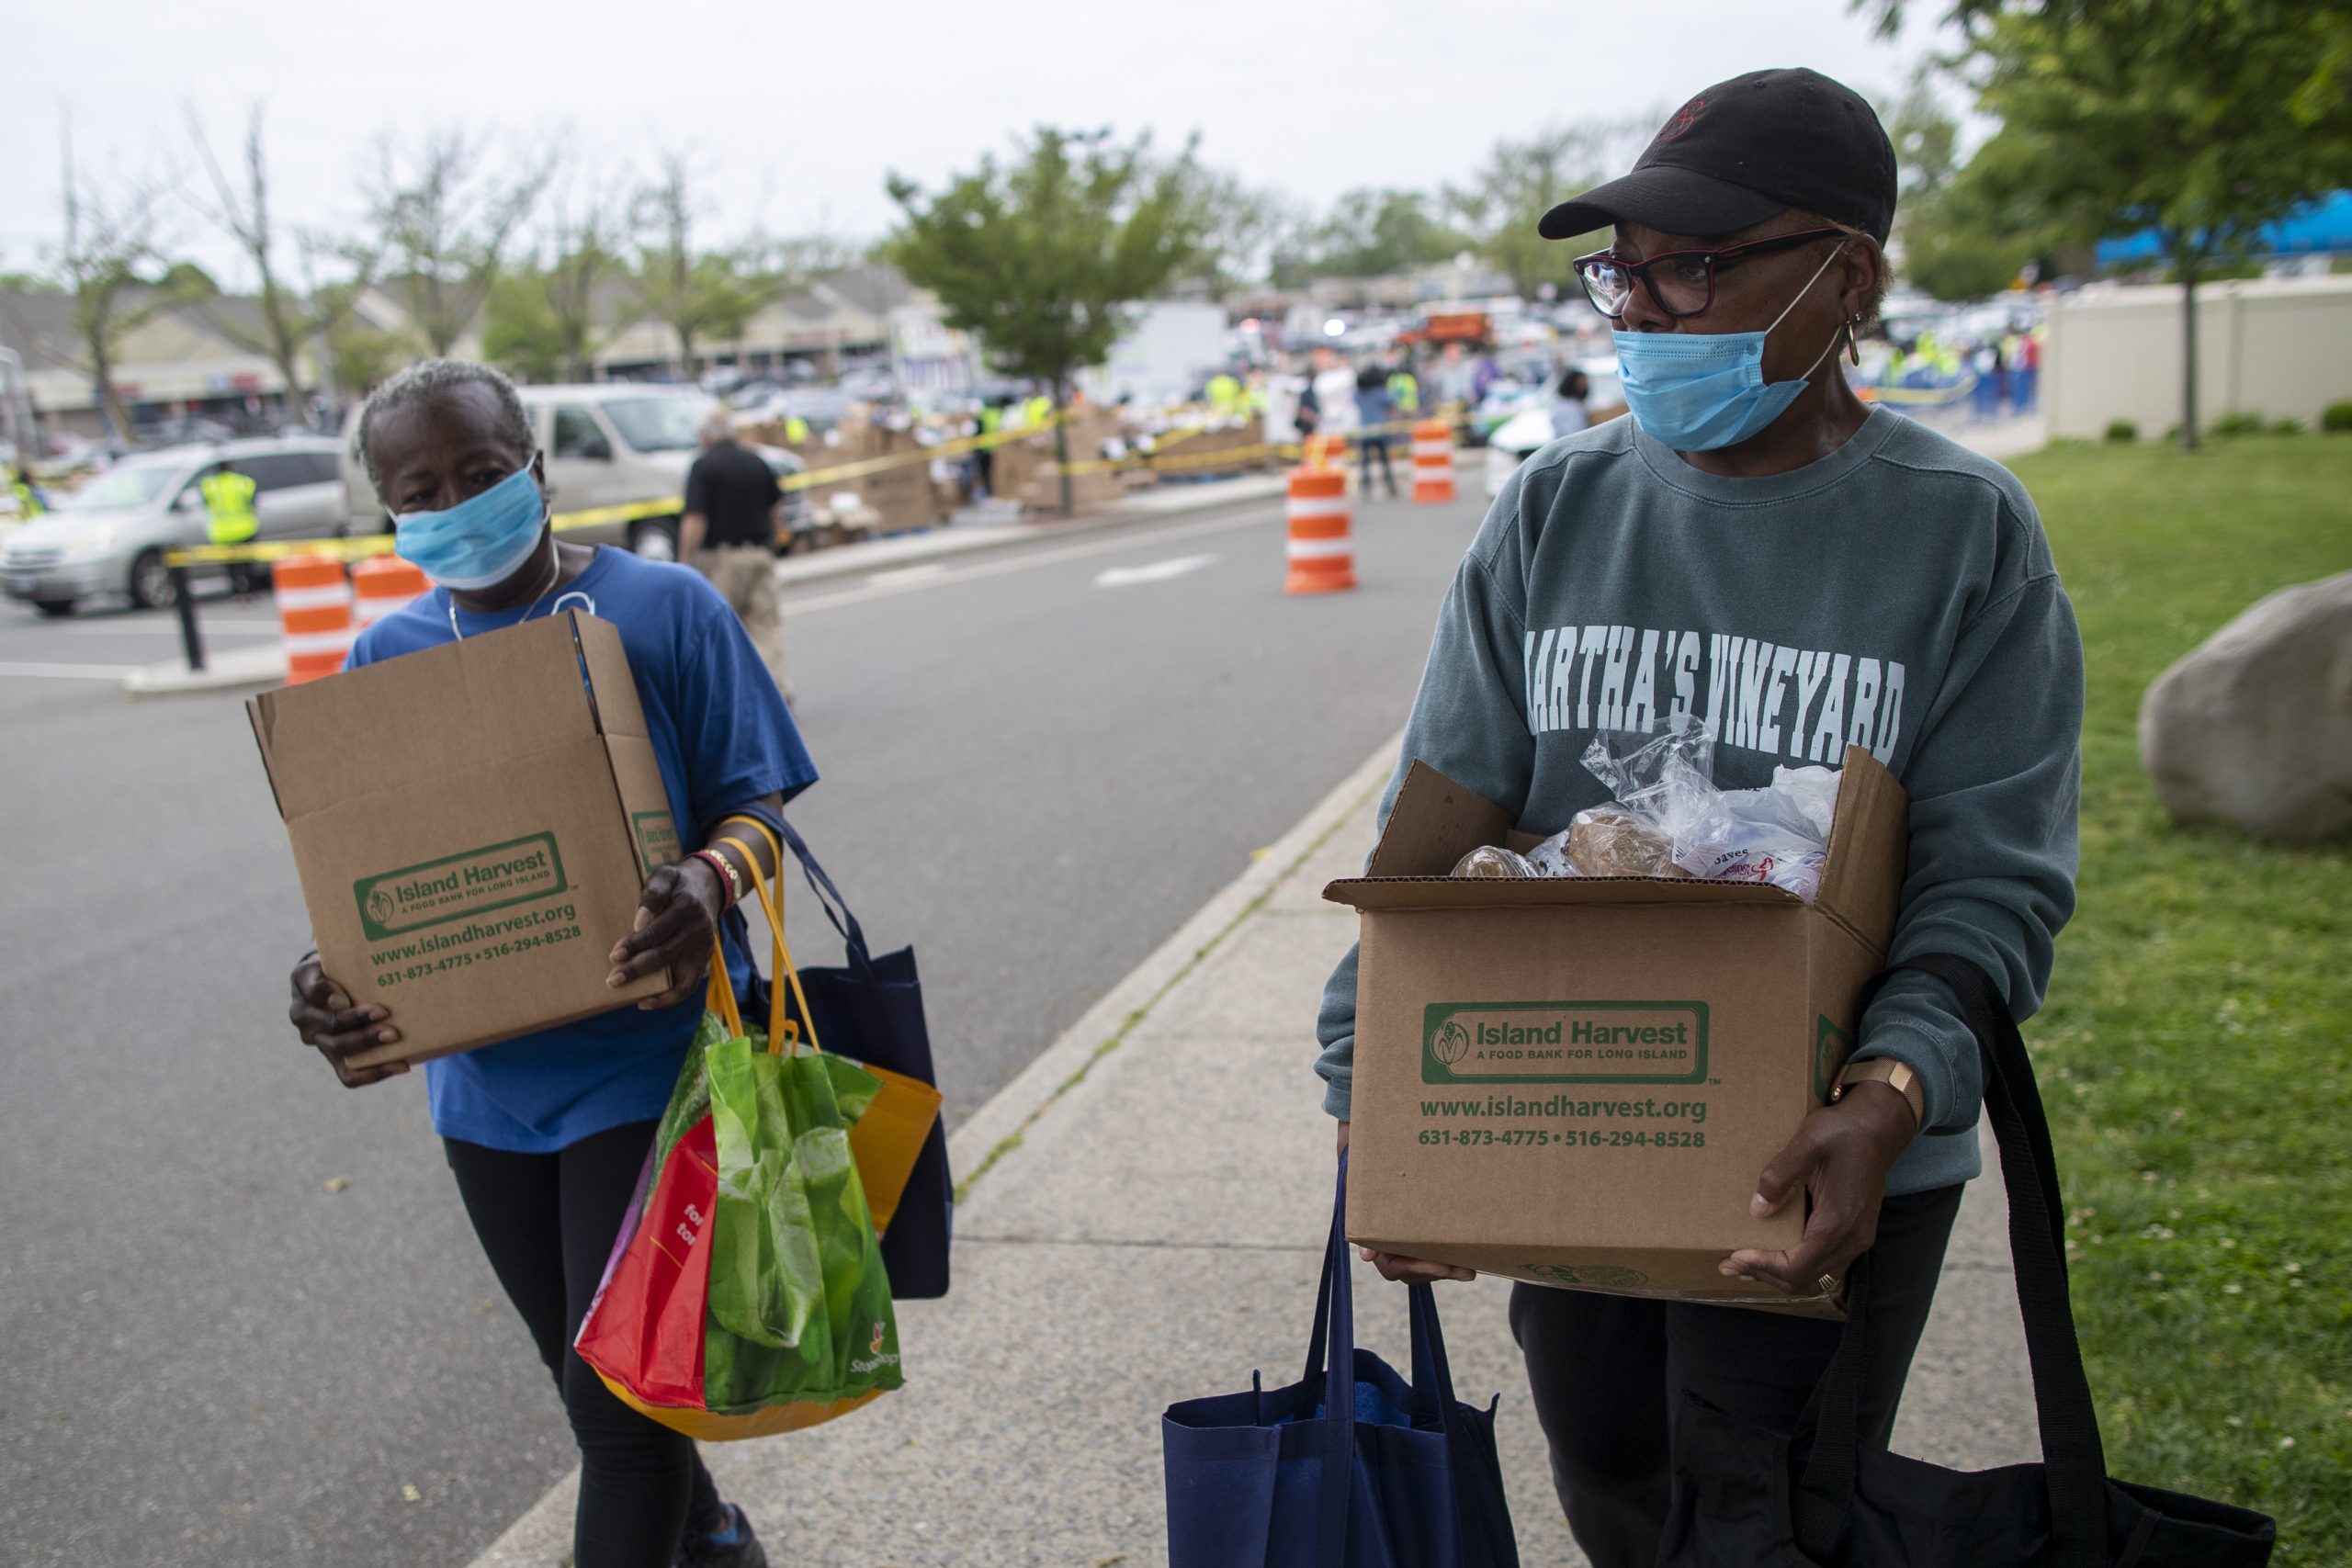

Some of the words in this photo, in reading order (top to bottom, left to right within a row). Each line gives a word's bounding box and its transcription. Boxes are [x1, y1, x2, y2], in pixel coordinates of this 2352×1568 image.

[1705, 634, 1905, 769] VINEYARD
[396, 871, 459, 903] Island
[463, 850, 547, 886] Harvest
[410, 899, 435, 912] FOOD
[438, 893, 464, 906] BANK
[466, 886, 485, 897] FOR
[487, 879, 514, 892] LONG
[515, 870, 550, 885] ISLAND
[371, 903, 577, 966] www.islandharvest.org
[378, 952, 473, 987] 631-873-4775
[483, 925, 582, 961] 516-294-8528
[1476, 1021, 1562, 1045] Island
[1571, 1021, 1688, 1045] Harvest
[1476, 1050, 1485, 1060] A
[1489, 1050, 1523, 1060] FOOD
[1528, 1049, 1562, 1059] BANK
[1567, 1049, 1592, 1059] FOR
[1598, 1049, 1633, 1059] LONG
[1638, 1049, 1688, 1059] ISLAND
[1420, 1095, 1707, 1123] www.islandharvest.org
[1418, 1130, 1549, 1146] 631-873-4775
[1566, 1131, 1706, 1147] 516-294-8528
